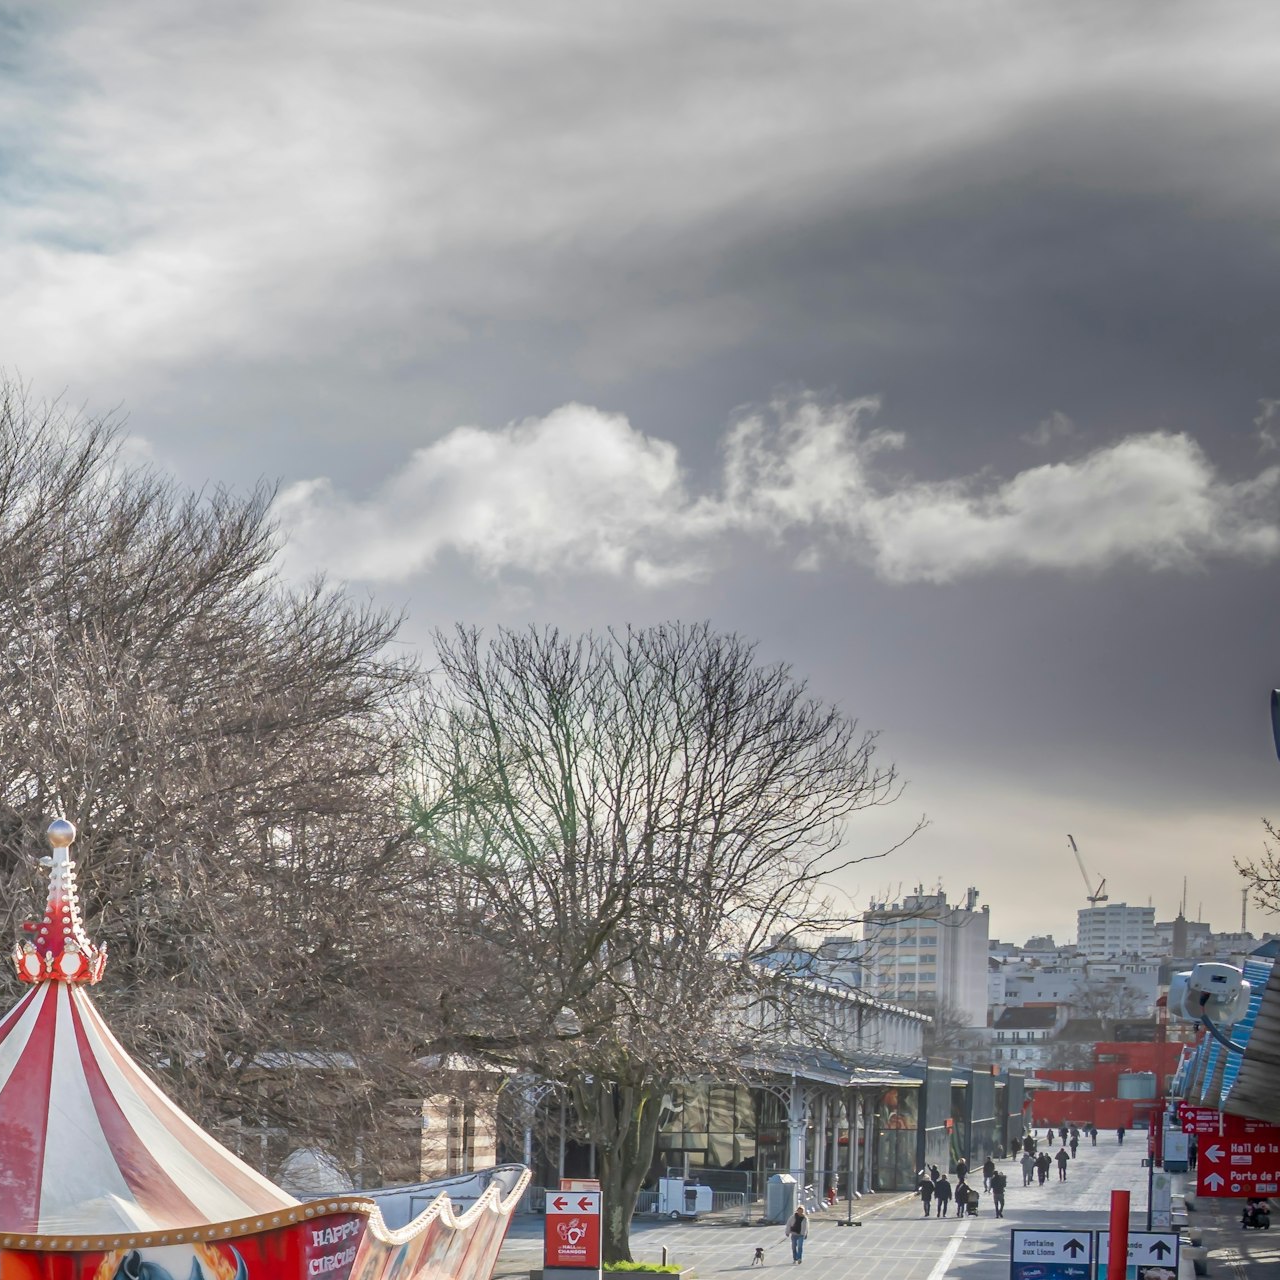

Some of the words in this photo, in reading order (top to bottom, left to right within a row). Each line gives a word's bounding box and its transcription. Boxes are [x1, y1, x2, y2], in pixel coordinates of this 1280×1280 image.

[1230, 1143, 1251, 1153] Hall
[1253, 1143, 1266, 1153] de
[1268, 1143, 1279, 1153] la
[1230, 1171, 1257, 1181] Porte
[1260, 1171, 1272, 1181] de
[311, 1218, 360, 1247] HAPPY
[1023, 1239, 1054, 1248] Fontaine
[1036, 1248, 1056, 1256] Lions
[309, 1246, 356, 1275] CIRCUS
